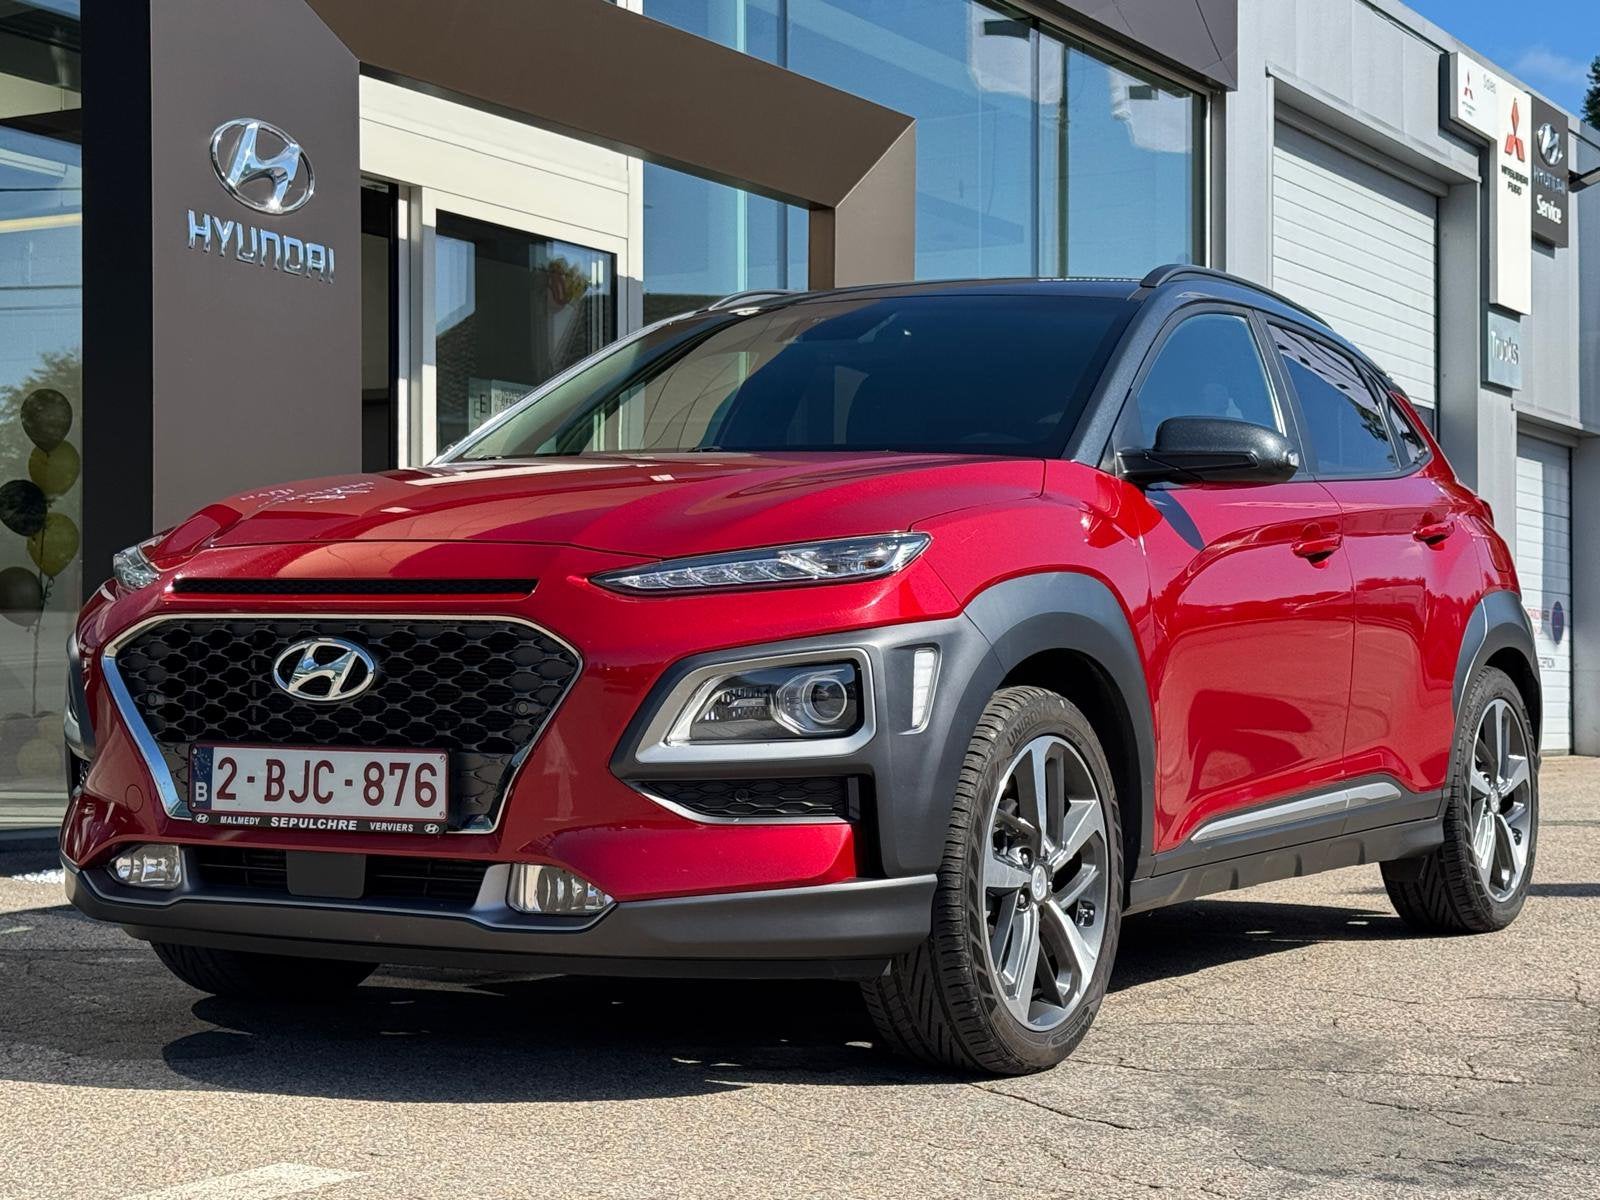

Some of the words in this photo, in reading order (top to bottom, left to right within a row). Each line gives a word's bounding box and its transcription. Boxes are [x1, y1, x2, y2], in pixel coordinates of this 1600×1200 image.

[1536, 194, 1562, 224] Service
[187, 209, 335, 284] HYUNDAI
[195, 781, 207, 801] B
[216, 756, 438, 808] 2-BJC-876
[220, 815, 261, 825] MALMEDY
[270, 817, 358, 831] SEPULCHRE
[369, 822, 414, 832] VERVIERS
